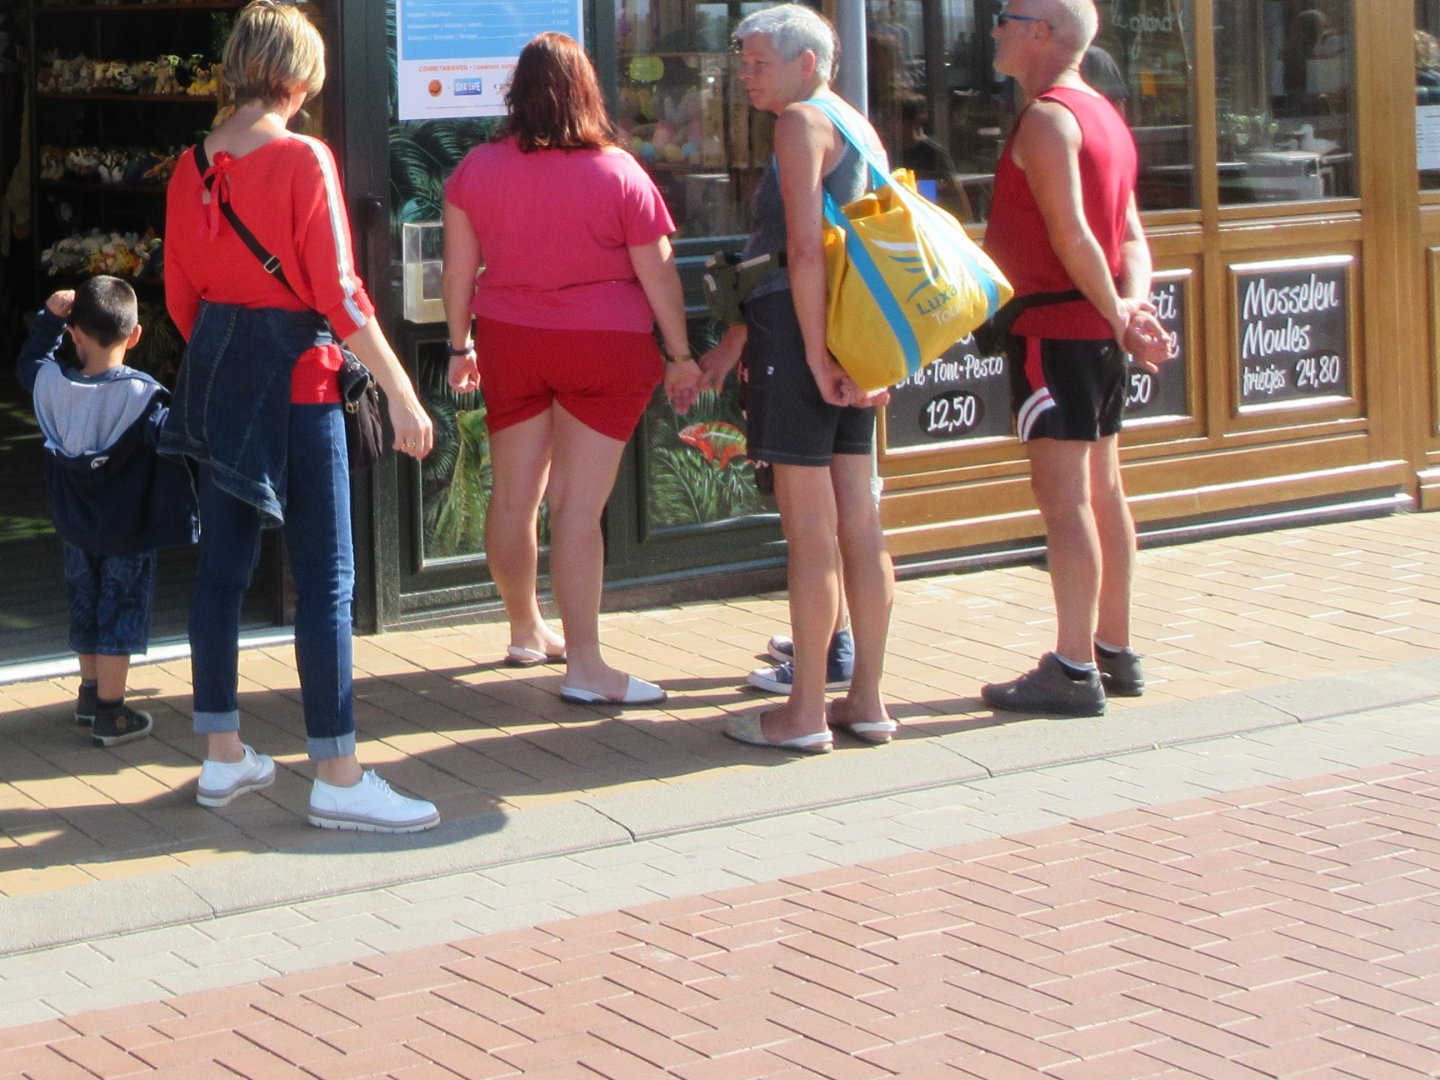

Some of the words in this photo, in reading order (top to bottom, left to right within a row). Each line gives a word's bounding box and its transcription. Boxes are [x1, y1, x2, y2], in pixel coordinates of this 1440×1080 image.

[916, 284, 958, 314] Luxa
[1243, 273, 1338, 320] Mosselen
[1242, 317, 1310, 359] Moules
[1125, 374, 1151, 407] ,50
[1243, 364, 1286, 396] frietjes
[1296, 355, 1339, 388] 24,80
[926, 396, 976, 432] 12,50
